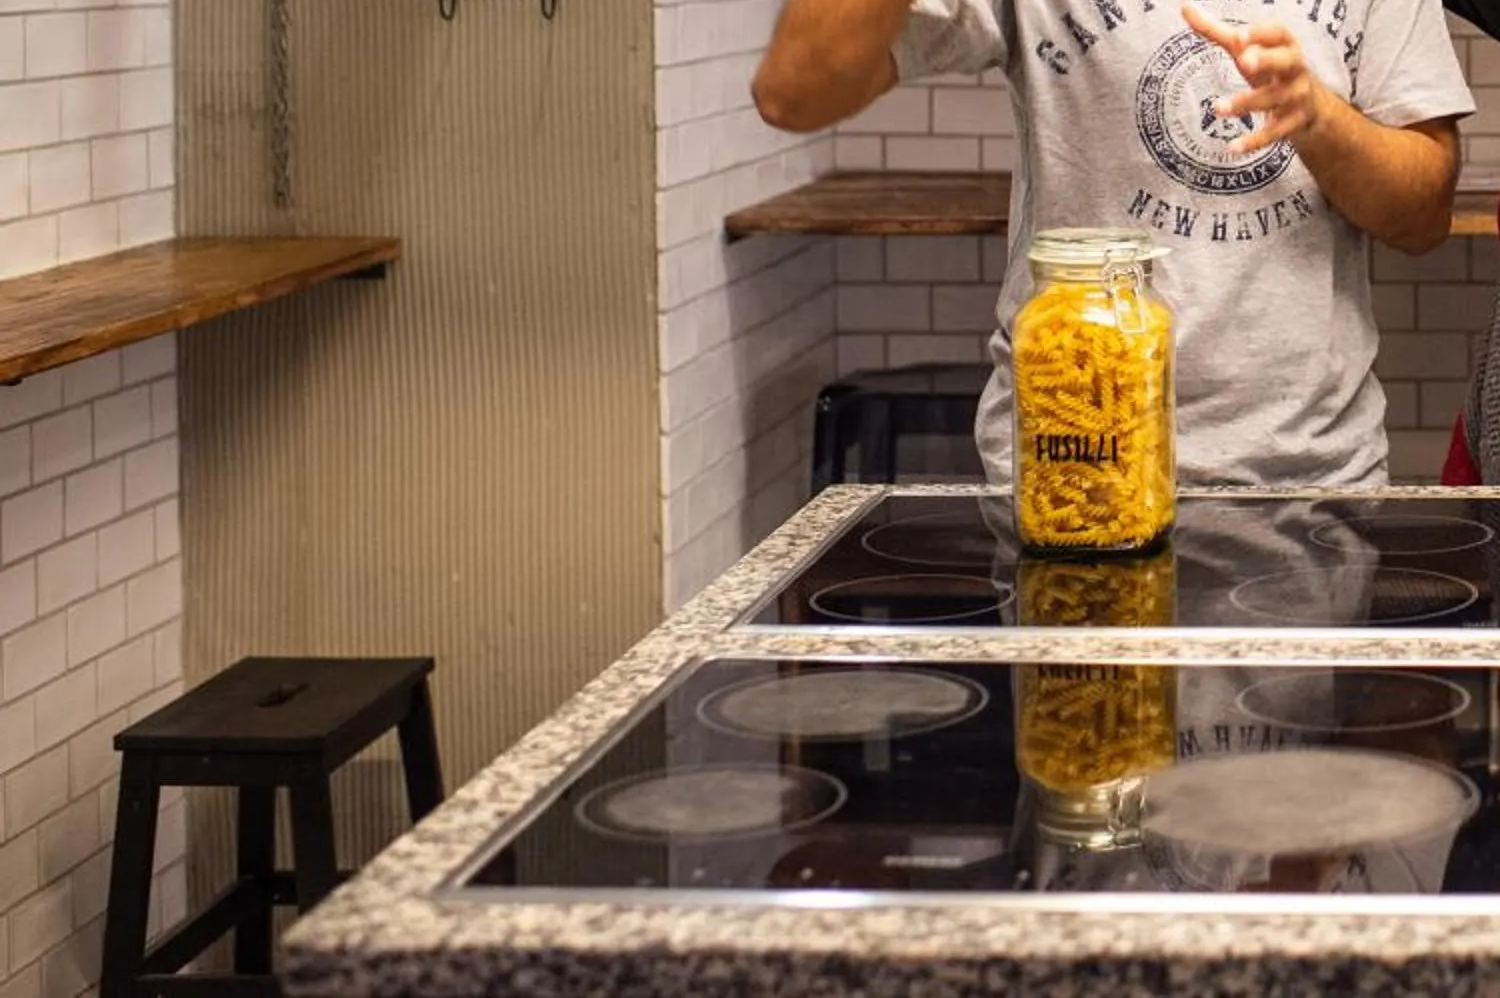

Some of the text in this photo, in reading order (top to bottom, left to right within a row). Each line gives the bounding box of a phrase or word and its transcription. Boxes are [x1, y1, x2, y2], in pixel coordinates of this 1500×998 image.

[1128, 189, 1313, 241] NEW HAVEN
[1035, 432, 1117, 463] FUSILLI
